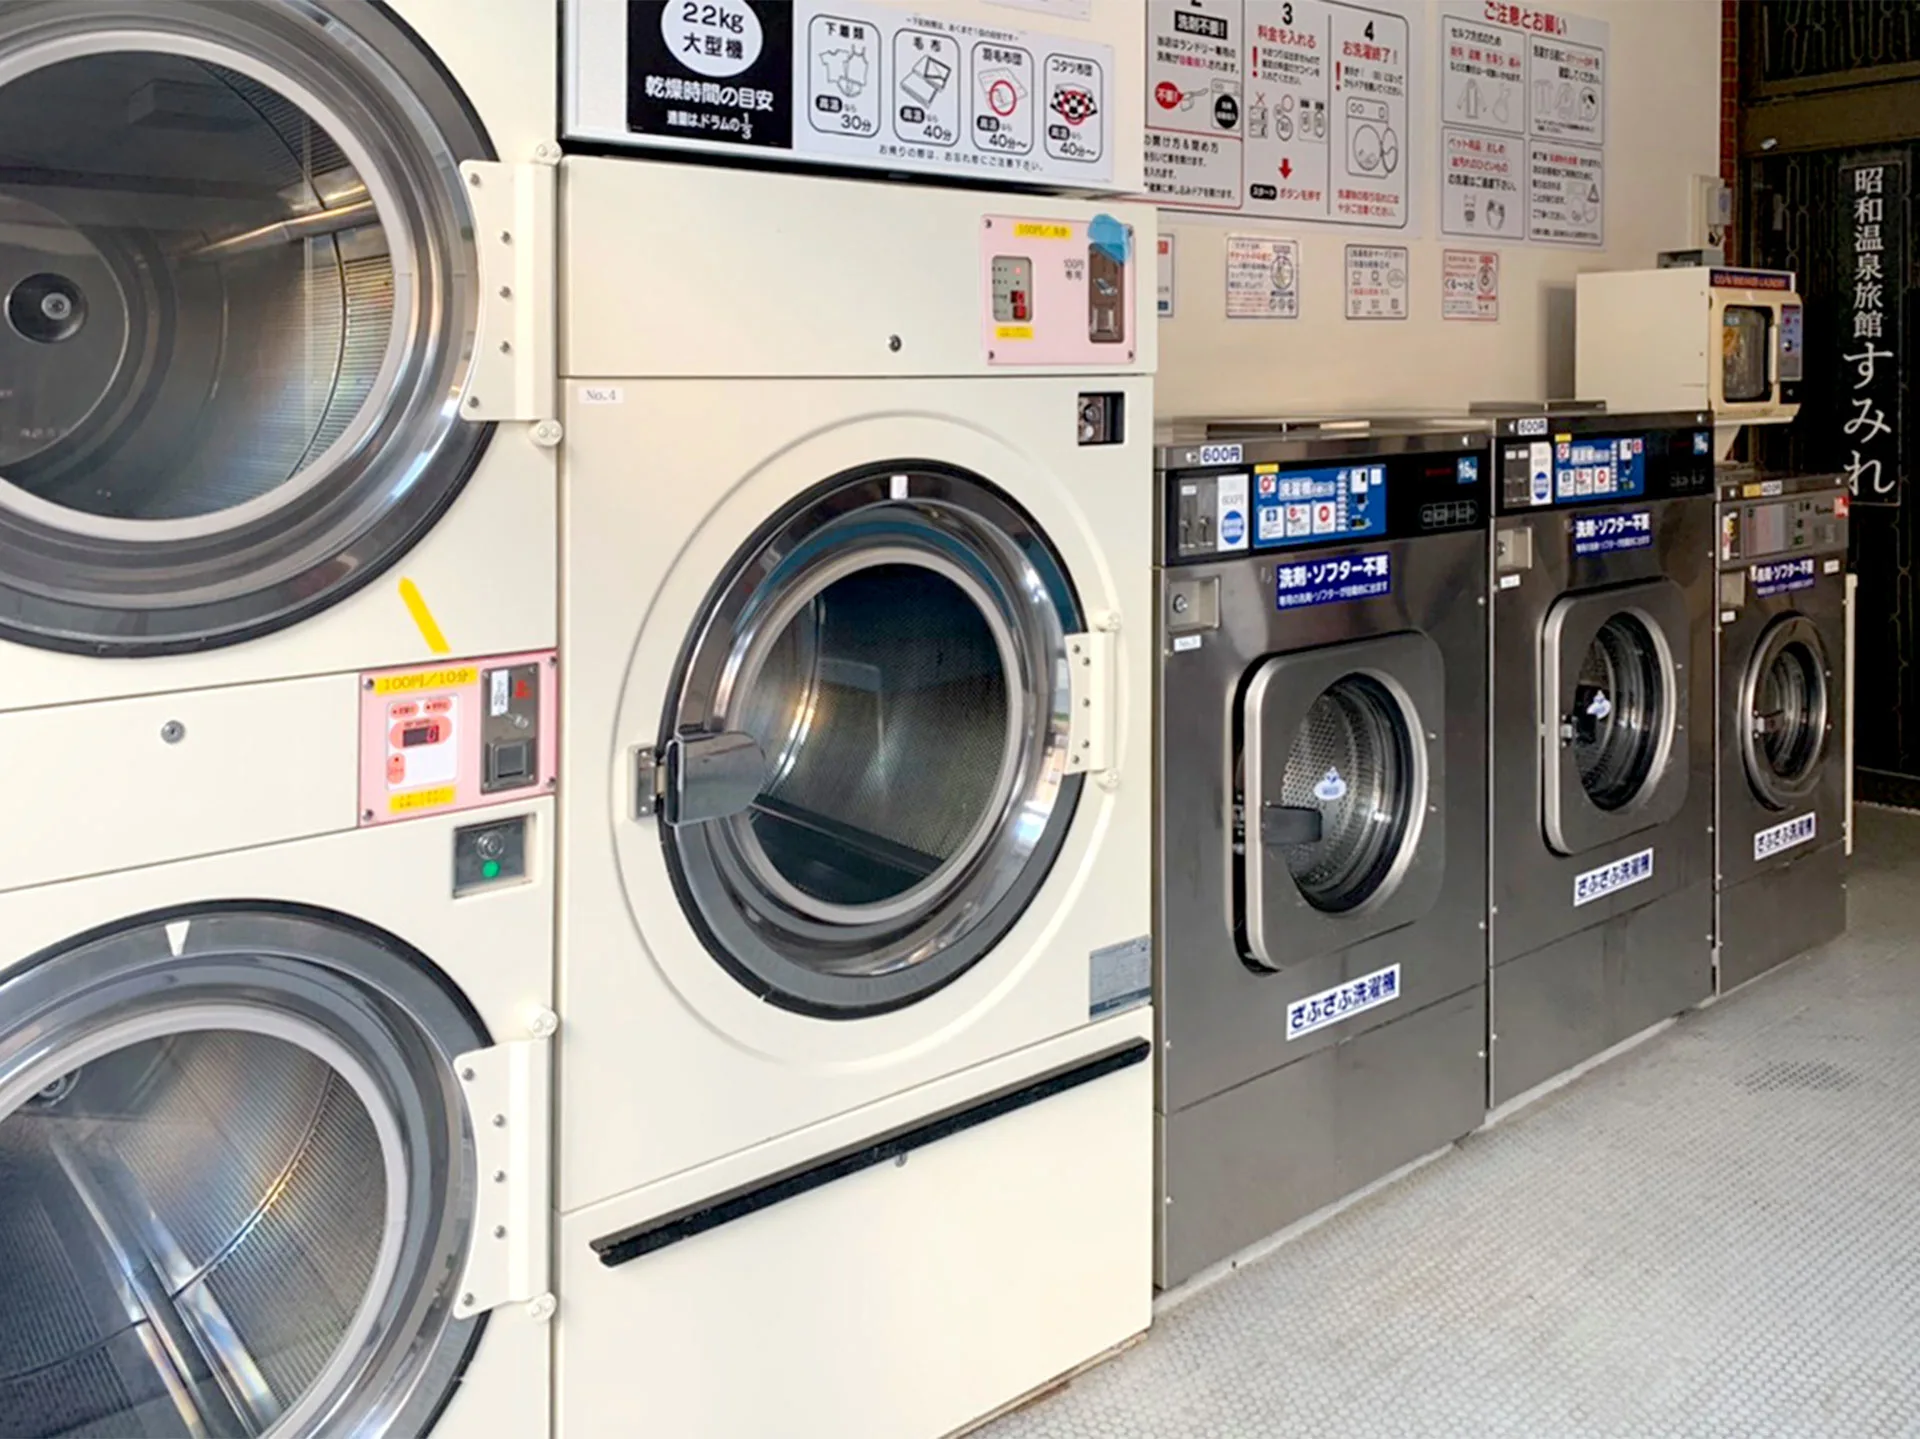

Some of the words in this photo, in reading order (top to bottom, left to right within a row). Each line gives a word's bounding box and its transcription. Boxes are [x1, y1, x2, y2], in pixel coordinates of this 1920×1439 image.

[682, 1, 745, 34] 22kg
[1282, 2, 1294, 26] 3
[1484, 0, 1568, 35] ご注意とお願い
[683, 32, 743, 60] 大型機
[1364, 20, 1374, 42] 4
[645, 76, 774, 112] 乾燥時間の目安
[841, 114, 872, 133] 30分
[923, 125, 953, 142] 40分
[1202, 446, 1240, 463] 600円
[1279, 553, 1389, 589] 洗剤・ソフター不要
[1577, 853, 1652, 899] ざぶざぶ洗濯機
[1290, 970, 1397, 1030] ざぶざぶ洗濯機
